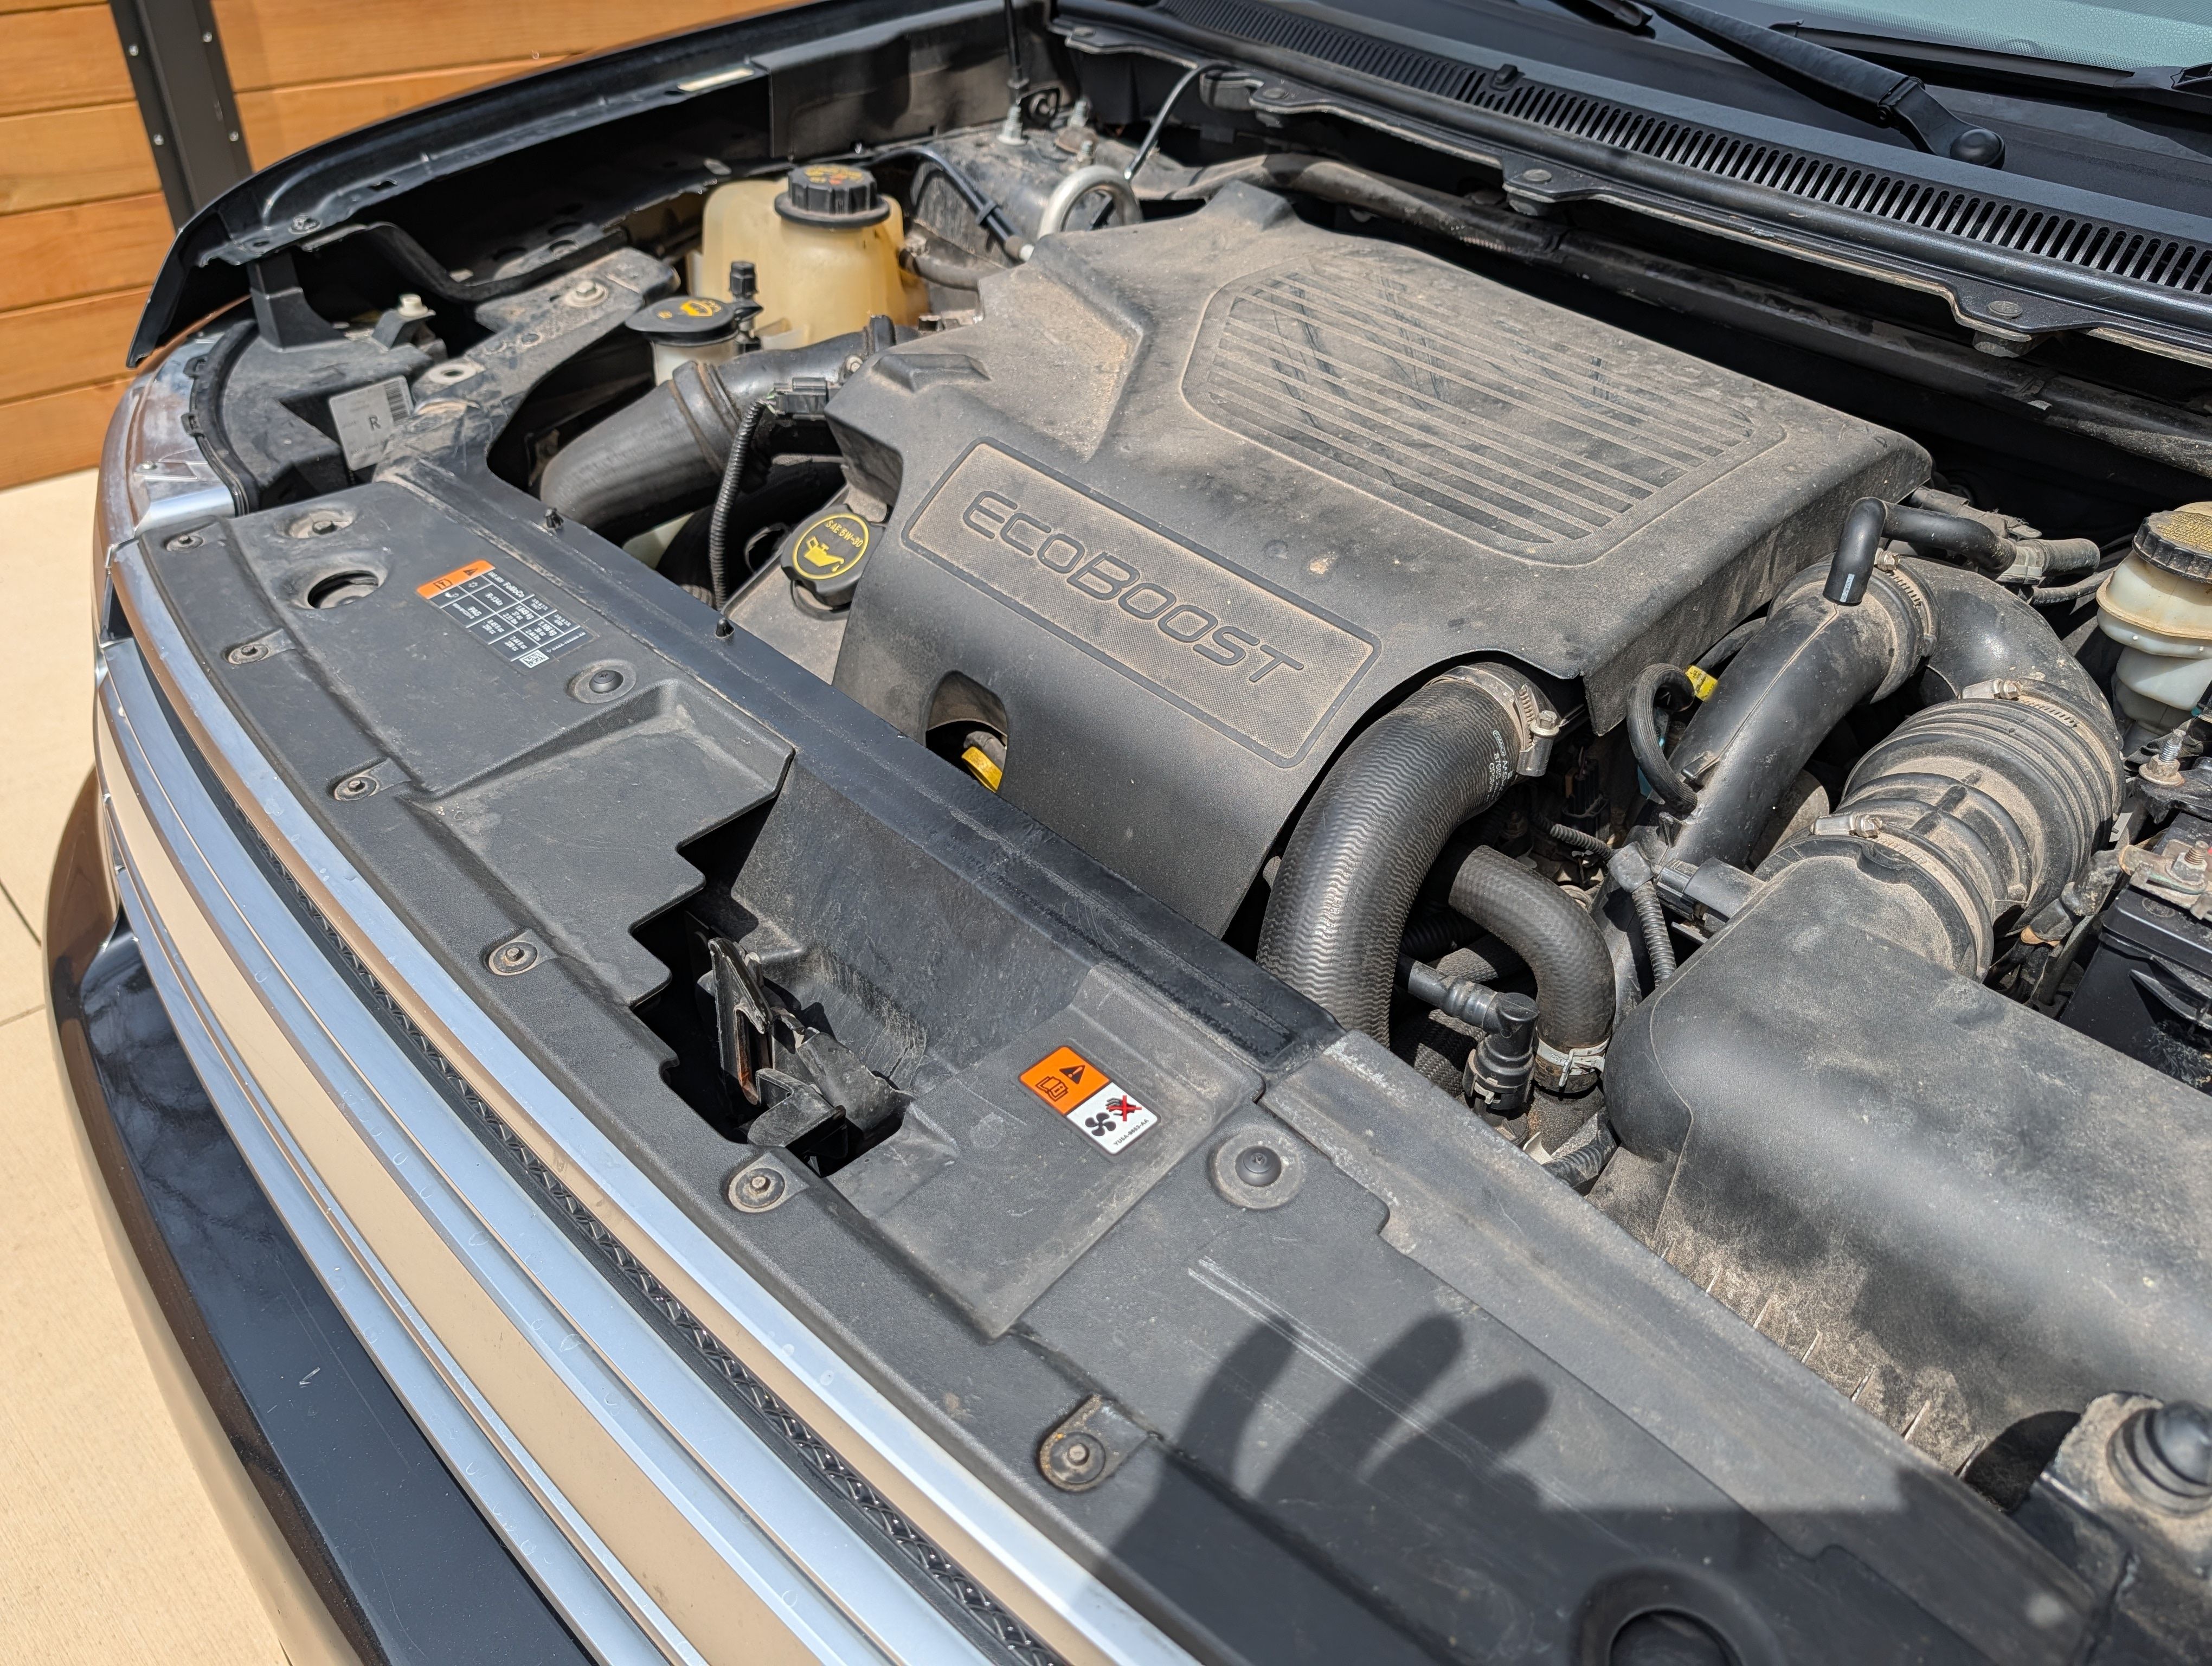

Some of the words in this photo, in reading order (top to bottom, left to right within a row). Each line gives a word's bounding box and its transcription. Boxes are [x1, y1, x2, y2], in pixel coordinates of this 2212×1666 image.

[369, 414, 381, 431] R
[826, 520, 841, 534] SAE
[839, 529, 864, 548] 5W-30
[503, 581, 524, 598] FoMoCo
[467, 606, 482, 617] PAG
[1494, 731, 1506, 756] FoMoCo
